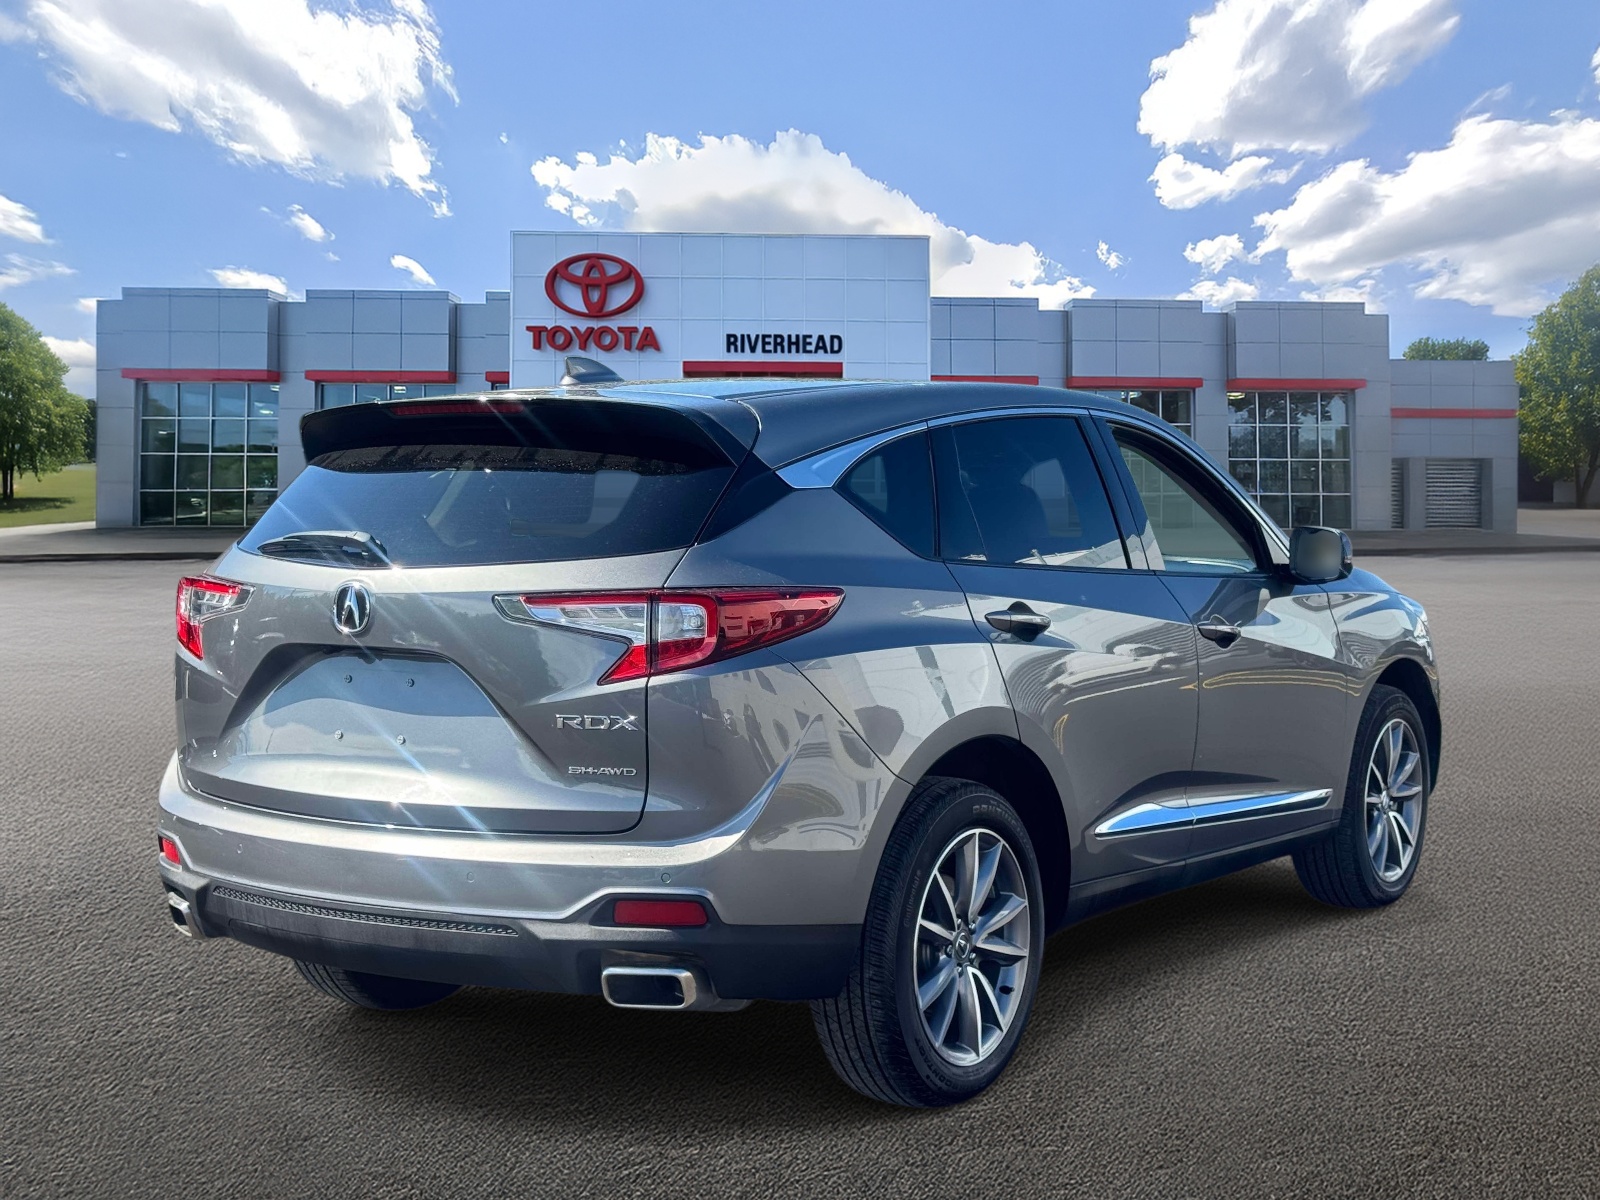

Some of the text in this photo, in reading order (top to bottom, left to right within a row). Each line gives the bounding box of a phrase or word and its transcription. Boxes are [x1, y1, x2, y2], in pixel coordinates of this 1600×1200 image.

[526, 325, 661, 352] TOYOTA
[725, 333, 843, 355] RIVERHEAD
[555, 713, 639, 731] RDX
[568, 766, 637, 776] SH-AWD
